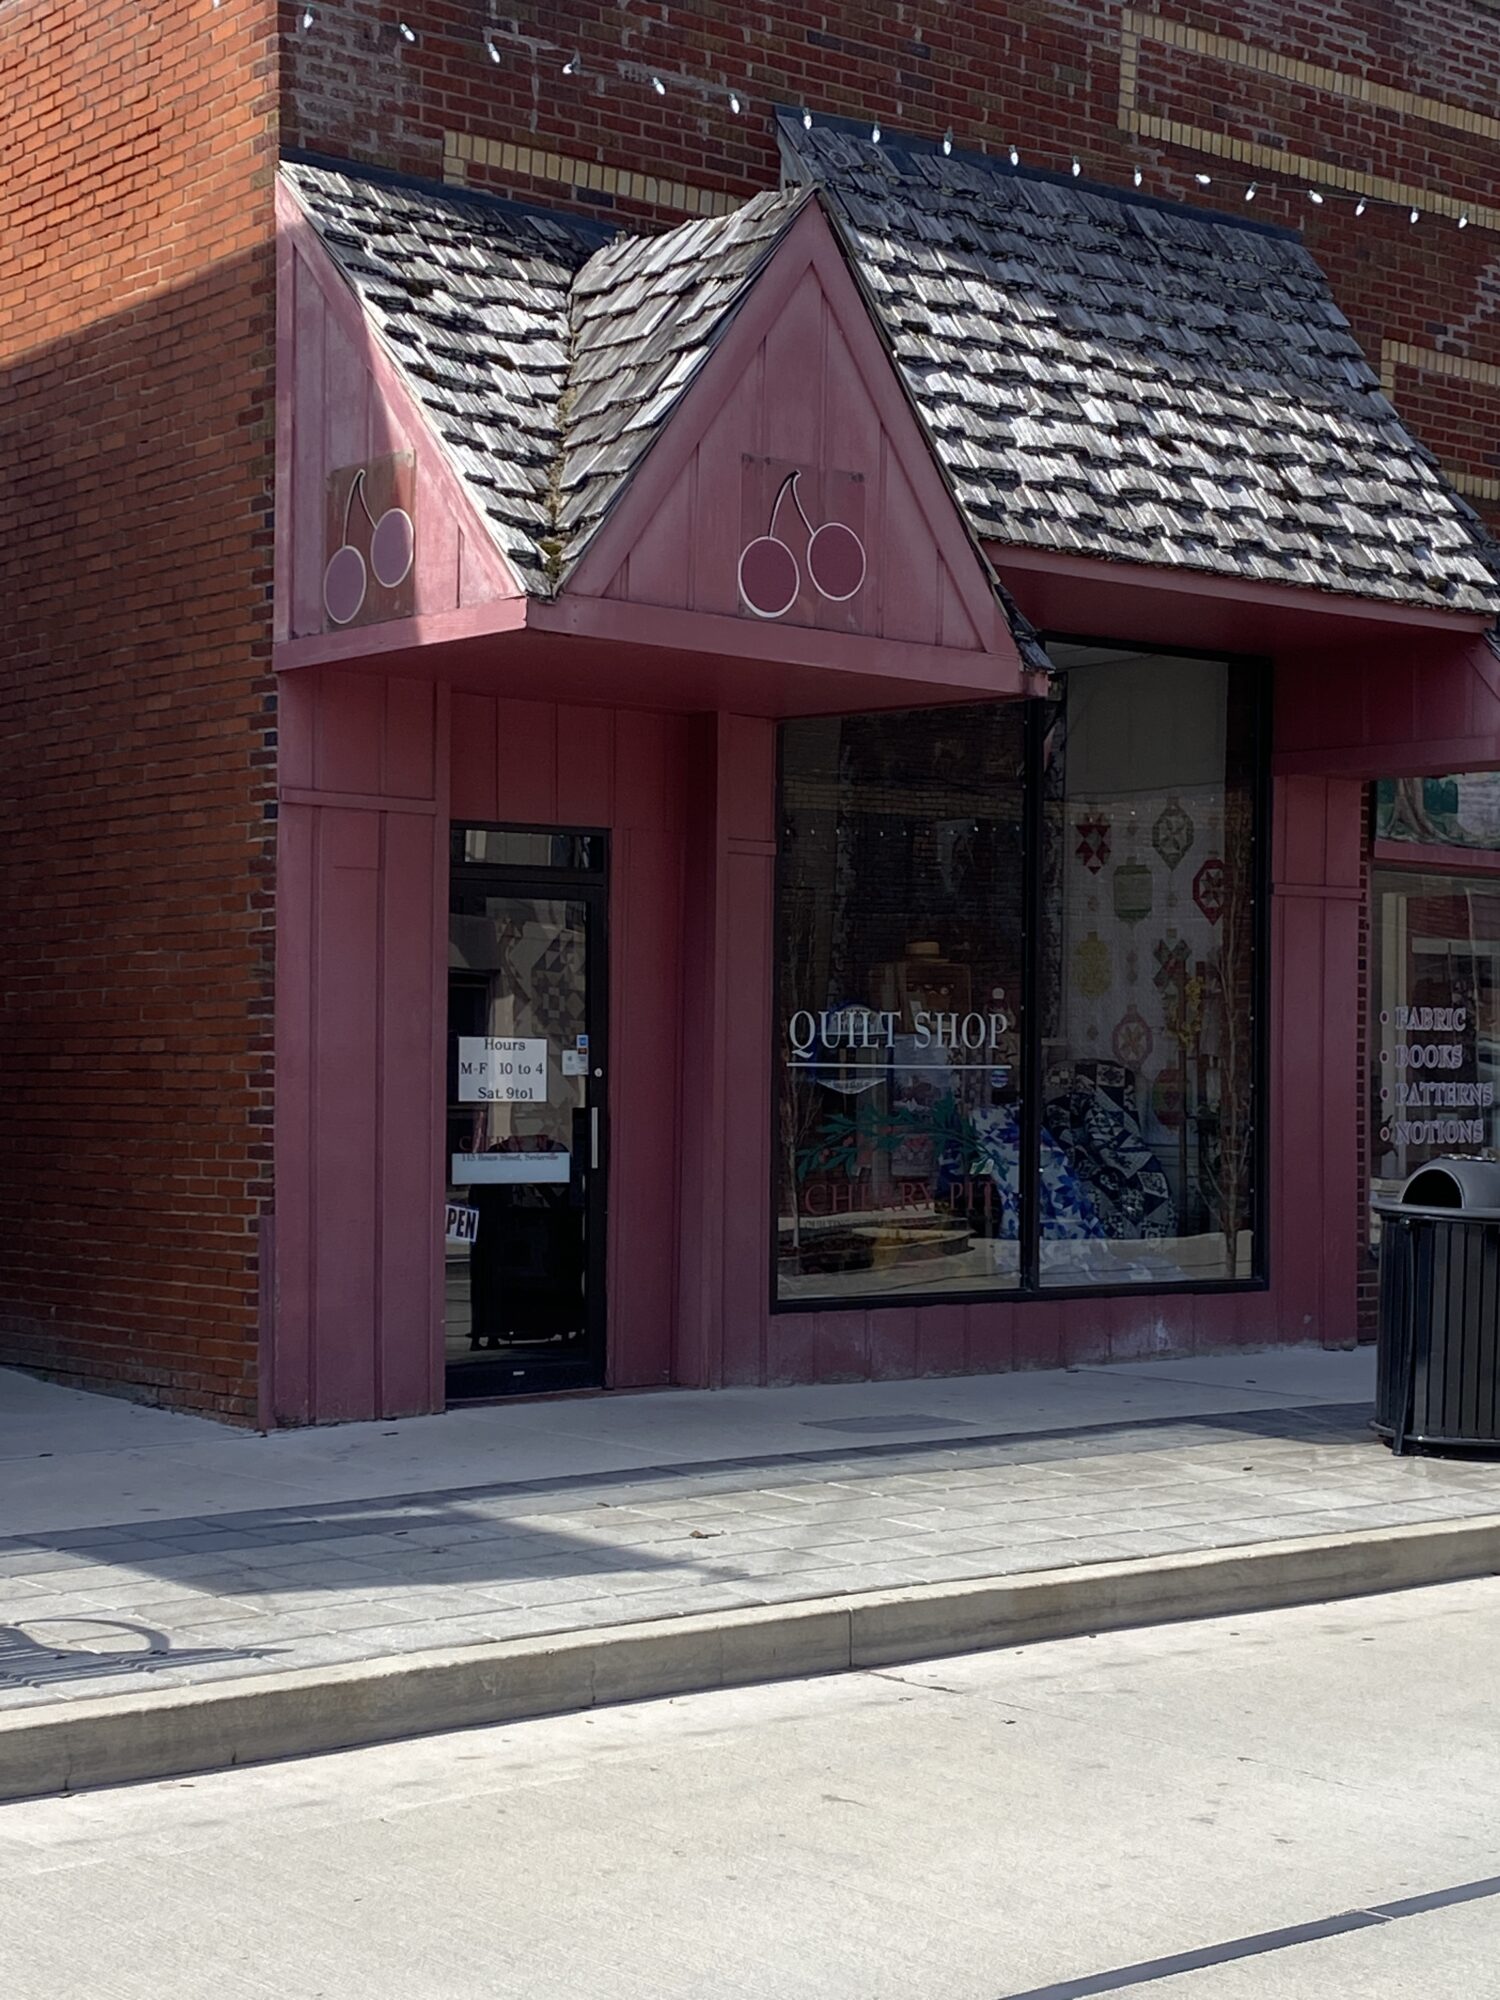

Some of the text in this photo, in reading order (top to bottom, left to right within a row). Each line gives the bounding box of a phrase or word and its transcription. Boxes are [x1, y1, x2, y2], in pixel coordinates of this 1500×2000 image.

[1395, 1006, 1467, 1032] FABRIC
[484, 1038, 526, 1051] Hours
[789, 1010, 1008, 1058] QUILT SHOP
[461, 1062, 544, 1075] M-F 10 to 4
[1395, 1044, 1463, 1069] BOOKS
[1395, 1082, 1494, 1107] PATTERNS
[1395, 1119, 1484, 1145] NOTIONS
[804, 1181, 996, 1215] CHERRY PIT
[445, 1207, 476, 1239] PEN
